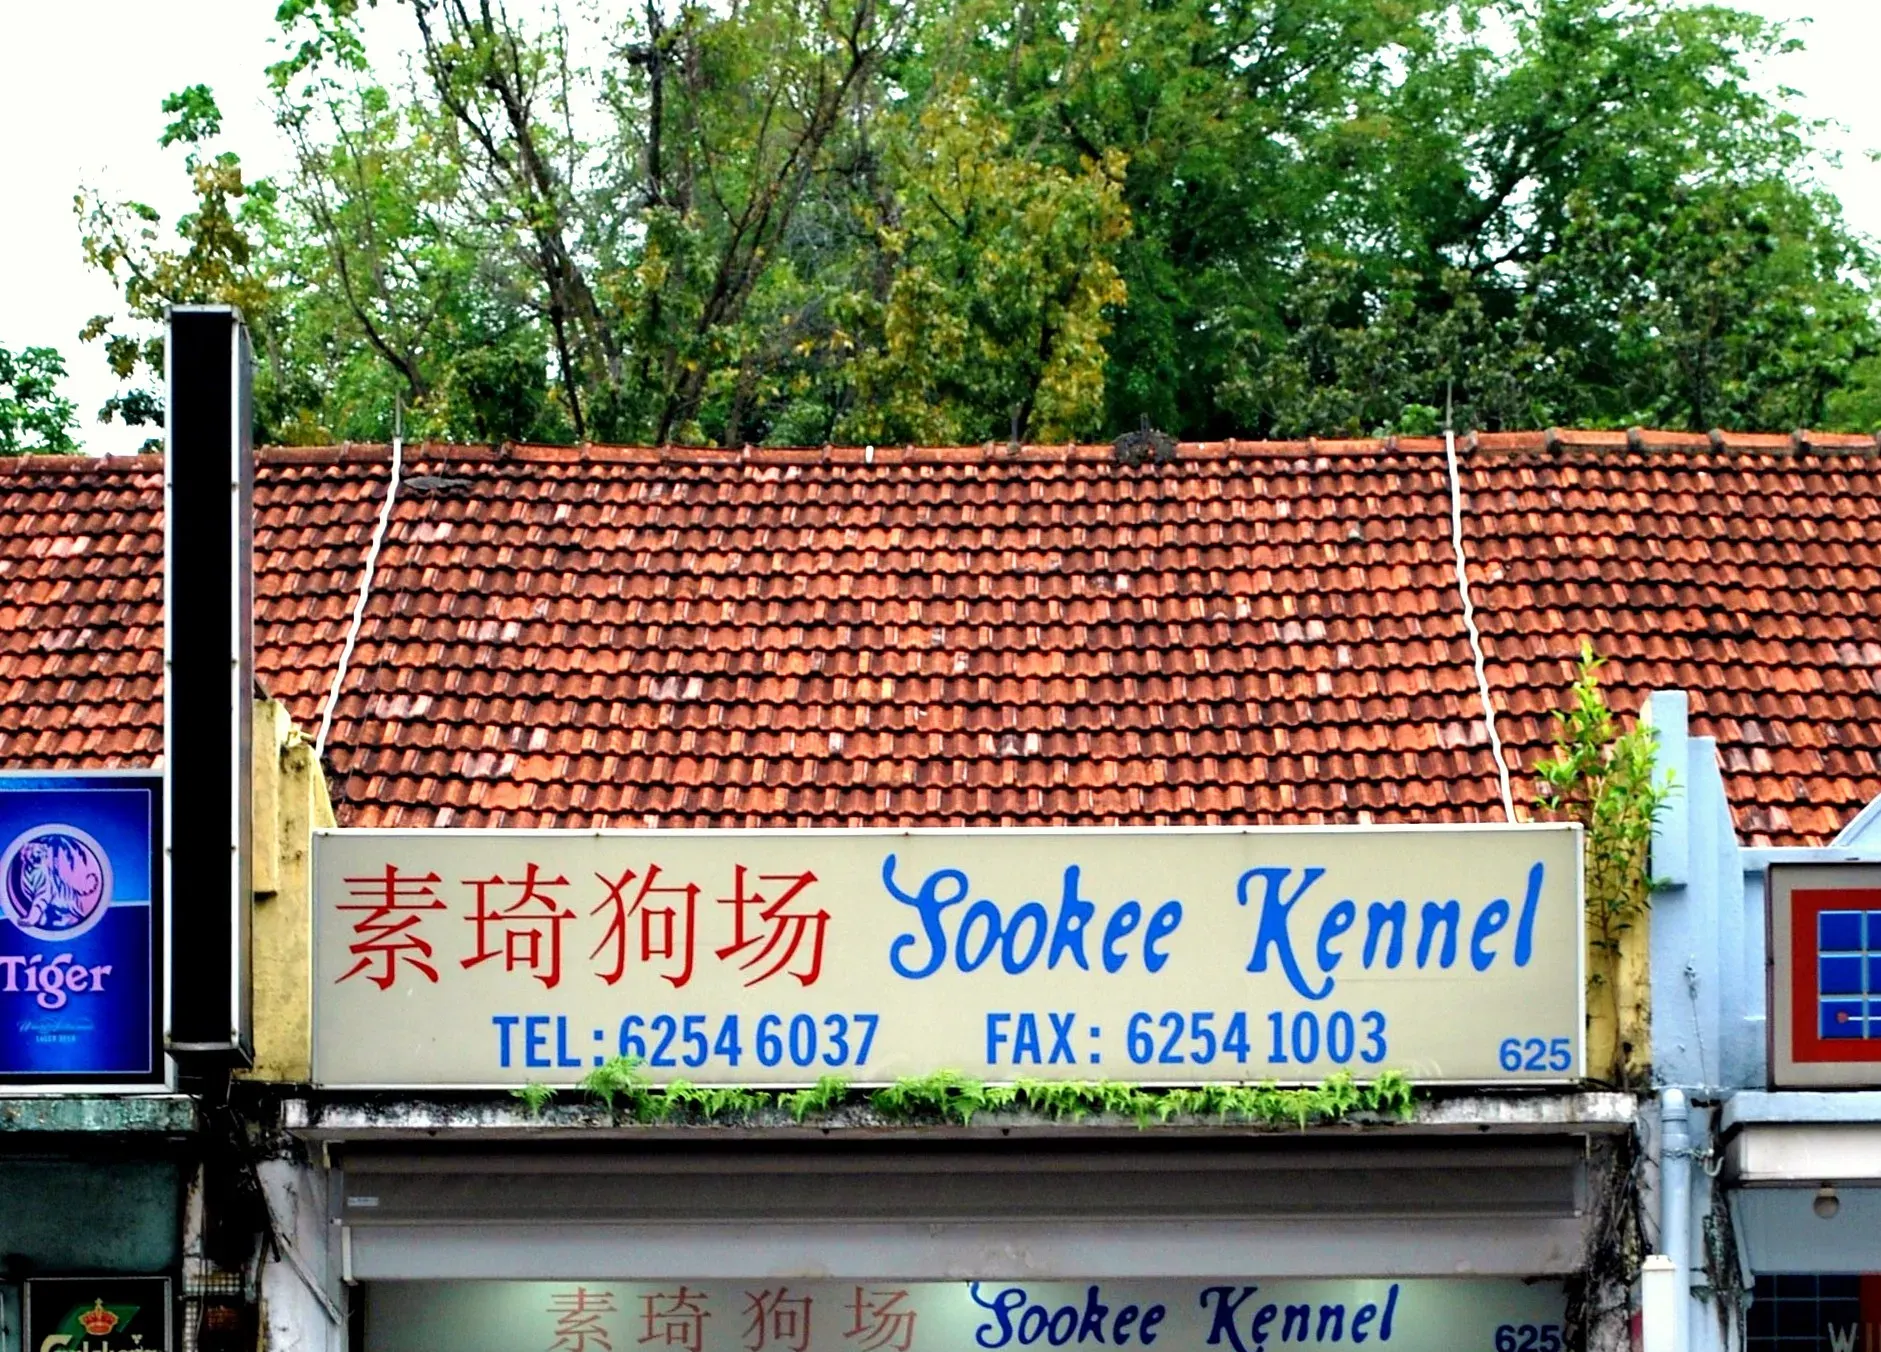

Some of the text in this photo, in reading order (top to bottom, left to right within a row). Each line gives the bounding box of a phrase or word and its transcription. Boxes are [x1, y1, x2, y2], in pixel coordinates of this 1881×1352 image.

[334, 861, 832, 991] 素琦狗场
[882, 853, 1545, 1000] Sookee Kennel
[0, 953, 112, 1010] Tiger
[757, 1013, 879, 1067] 6037
[1127, 1011, 1250, 1065] 6254
[1268, 1011, 1388, 1064] 1003
[1499, 1037, 1572, 1072] 625
[970, 1280, 1167, 1349] Sookee
